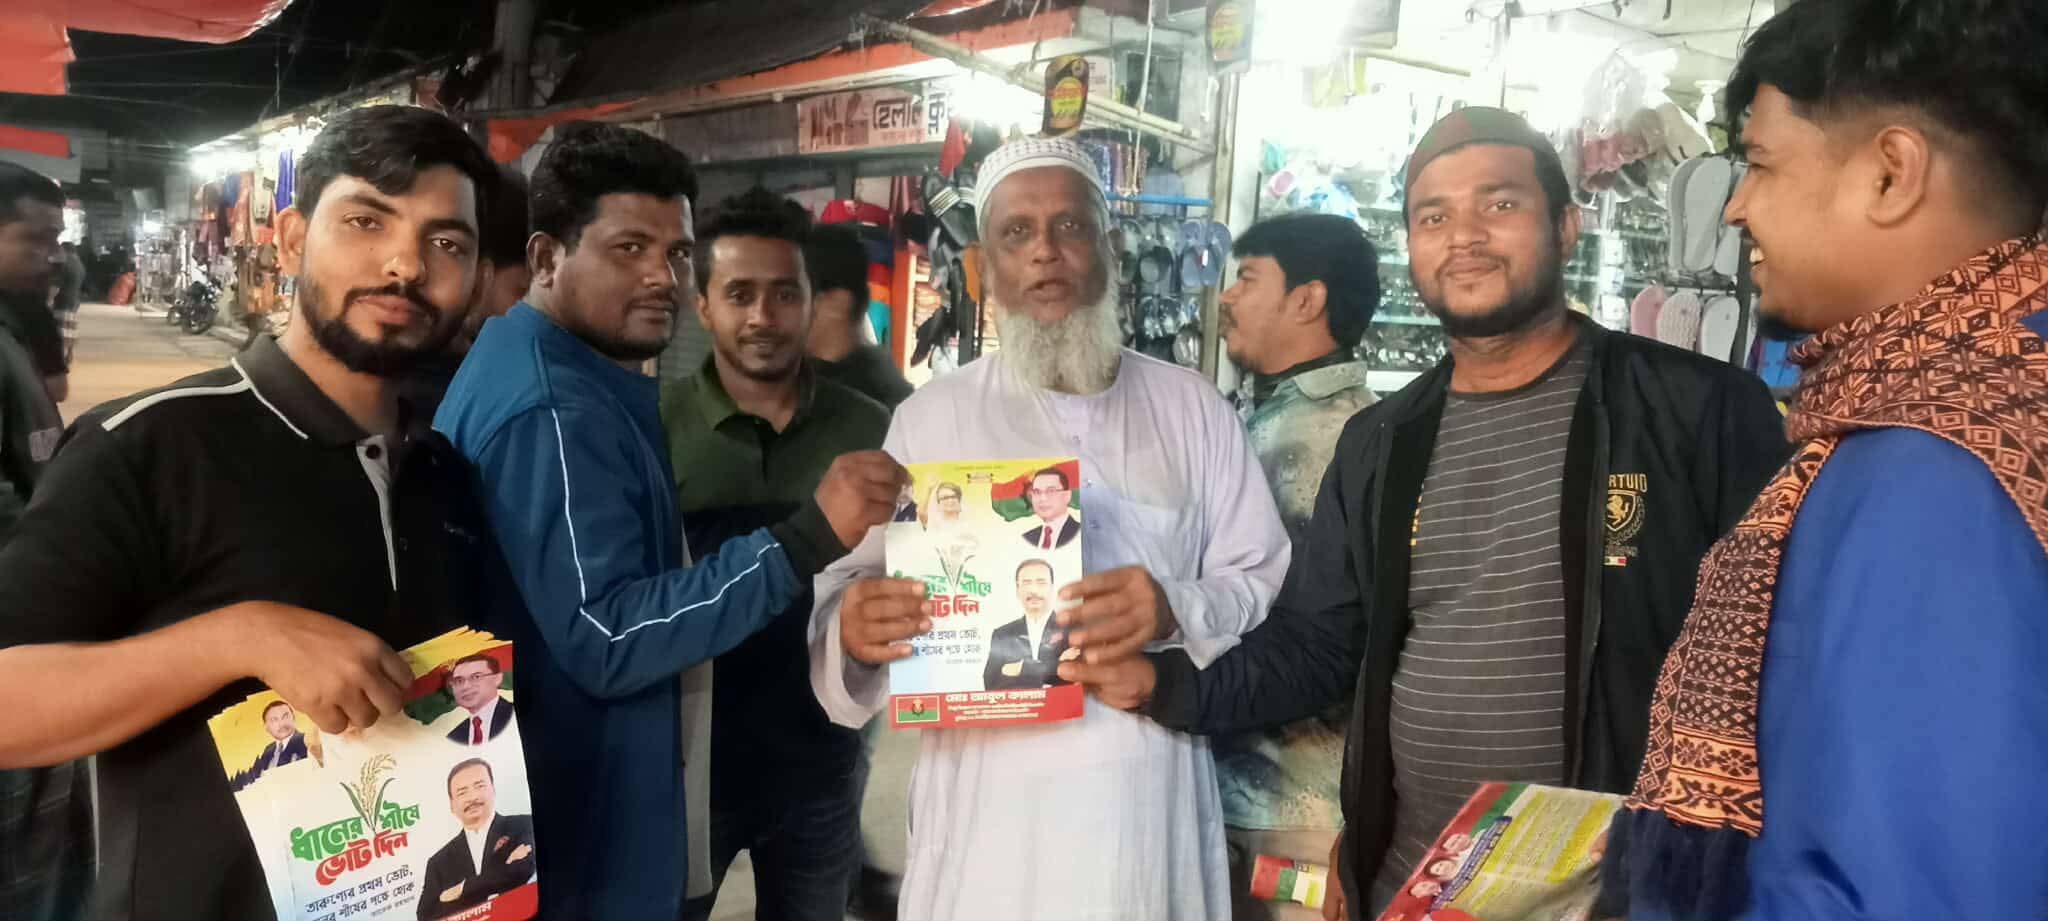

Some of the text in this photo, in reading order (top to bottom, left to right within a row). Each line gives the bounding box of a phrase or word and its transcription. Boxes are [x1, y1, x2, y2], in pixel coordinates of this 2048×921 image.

[953, 595, 979, 616] দিন
[290, 800, 420, 861] ধানের শীষে
[316, 829, 408, 885] ভোট দিন
[358, 876, 383, 895] প্রথম
